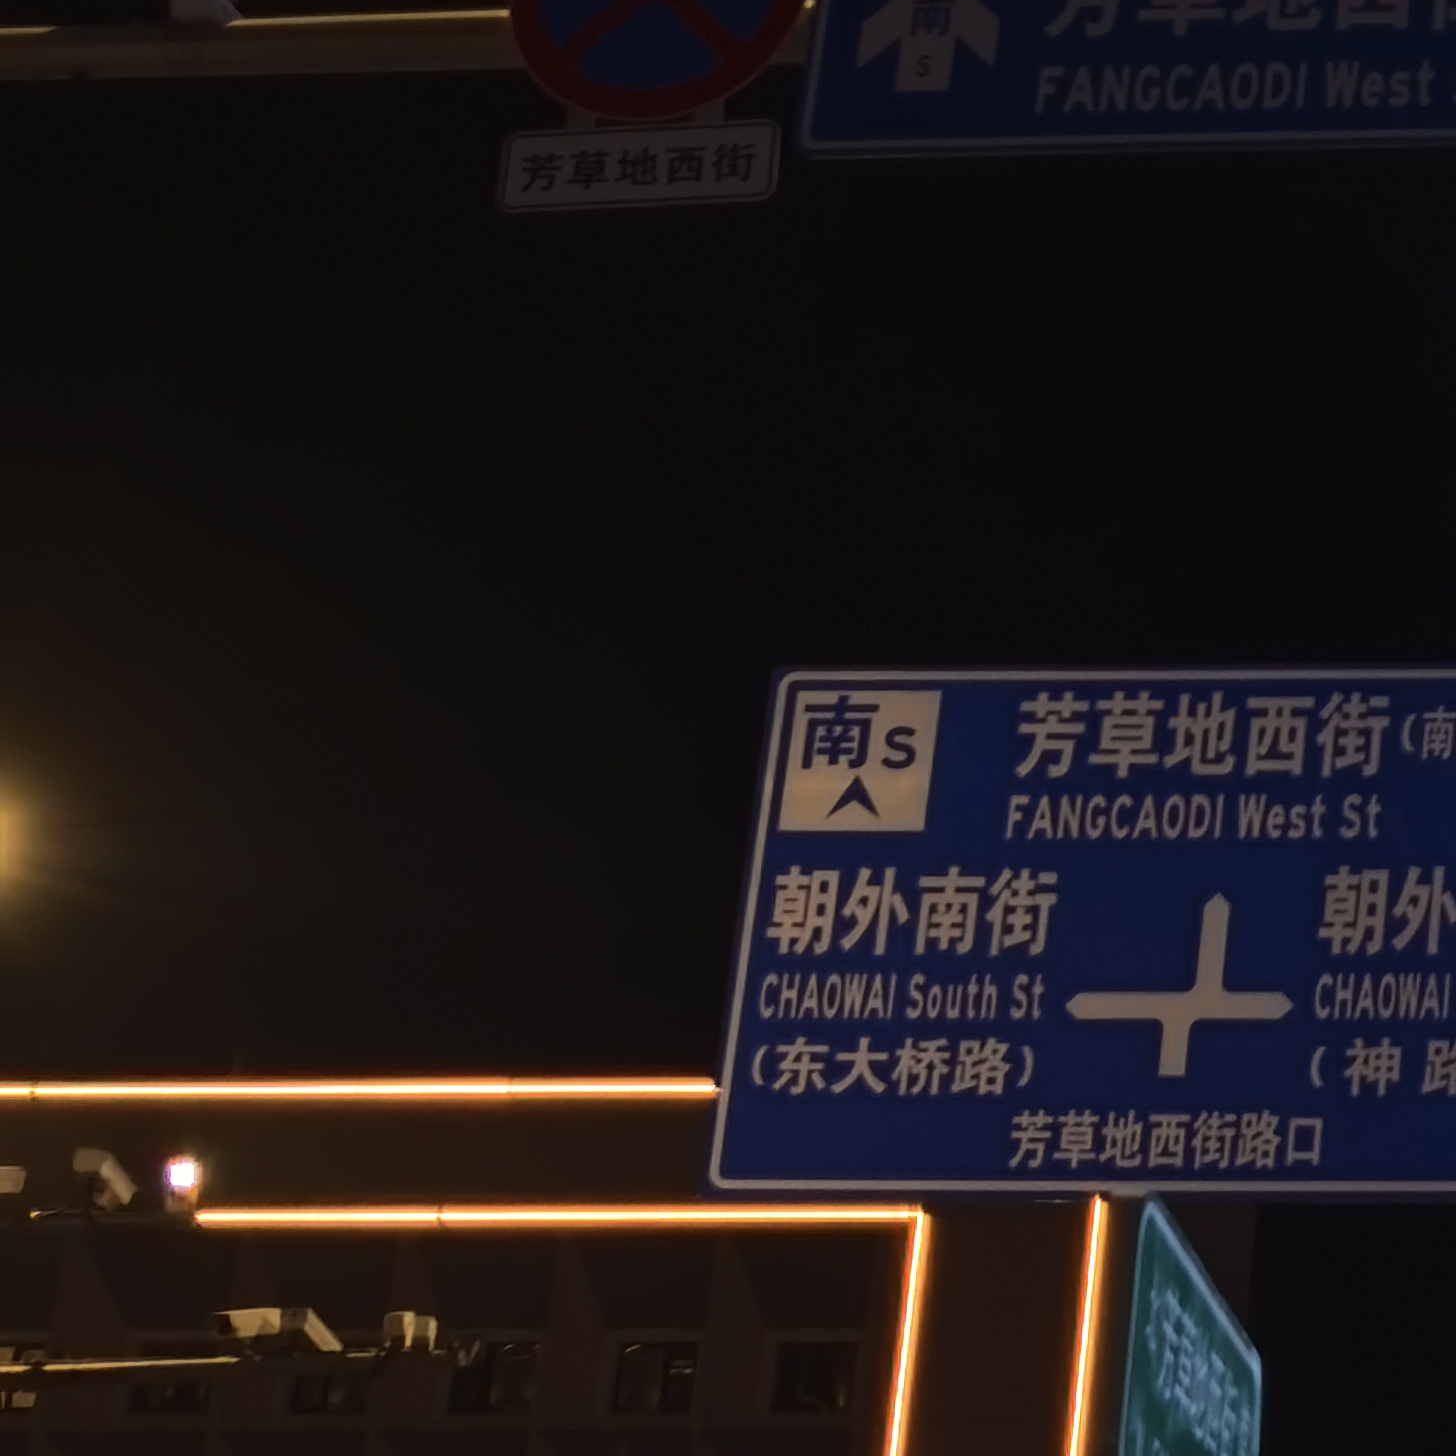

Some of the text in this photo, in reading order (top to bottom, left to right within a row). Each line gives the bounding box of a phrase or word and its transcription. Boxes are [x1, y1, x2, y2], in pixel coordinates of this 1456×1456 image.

[914, 54, 931, 78] S
[1034, 60, 1309, 115] FANGCAODI
[1324, 58, 1436, 109] West
[520, 142, 757, 193] 芳草地西街
[801, 695, 880, 769] 南
[1014, 690, 1392, 780] 芳草地西街
[1004, 793, 1382, 840] FANGCAODI West St
[765, 864, 1059, 957] 朝外南街
[758, 971, 1046, 1021] CHAOWAI South St
[1314, 971, 1453, 1021] CHAOWAI
[1008, 1108, 1325, 1170] 芳草地西街路口
